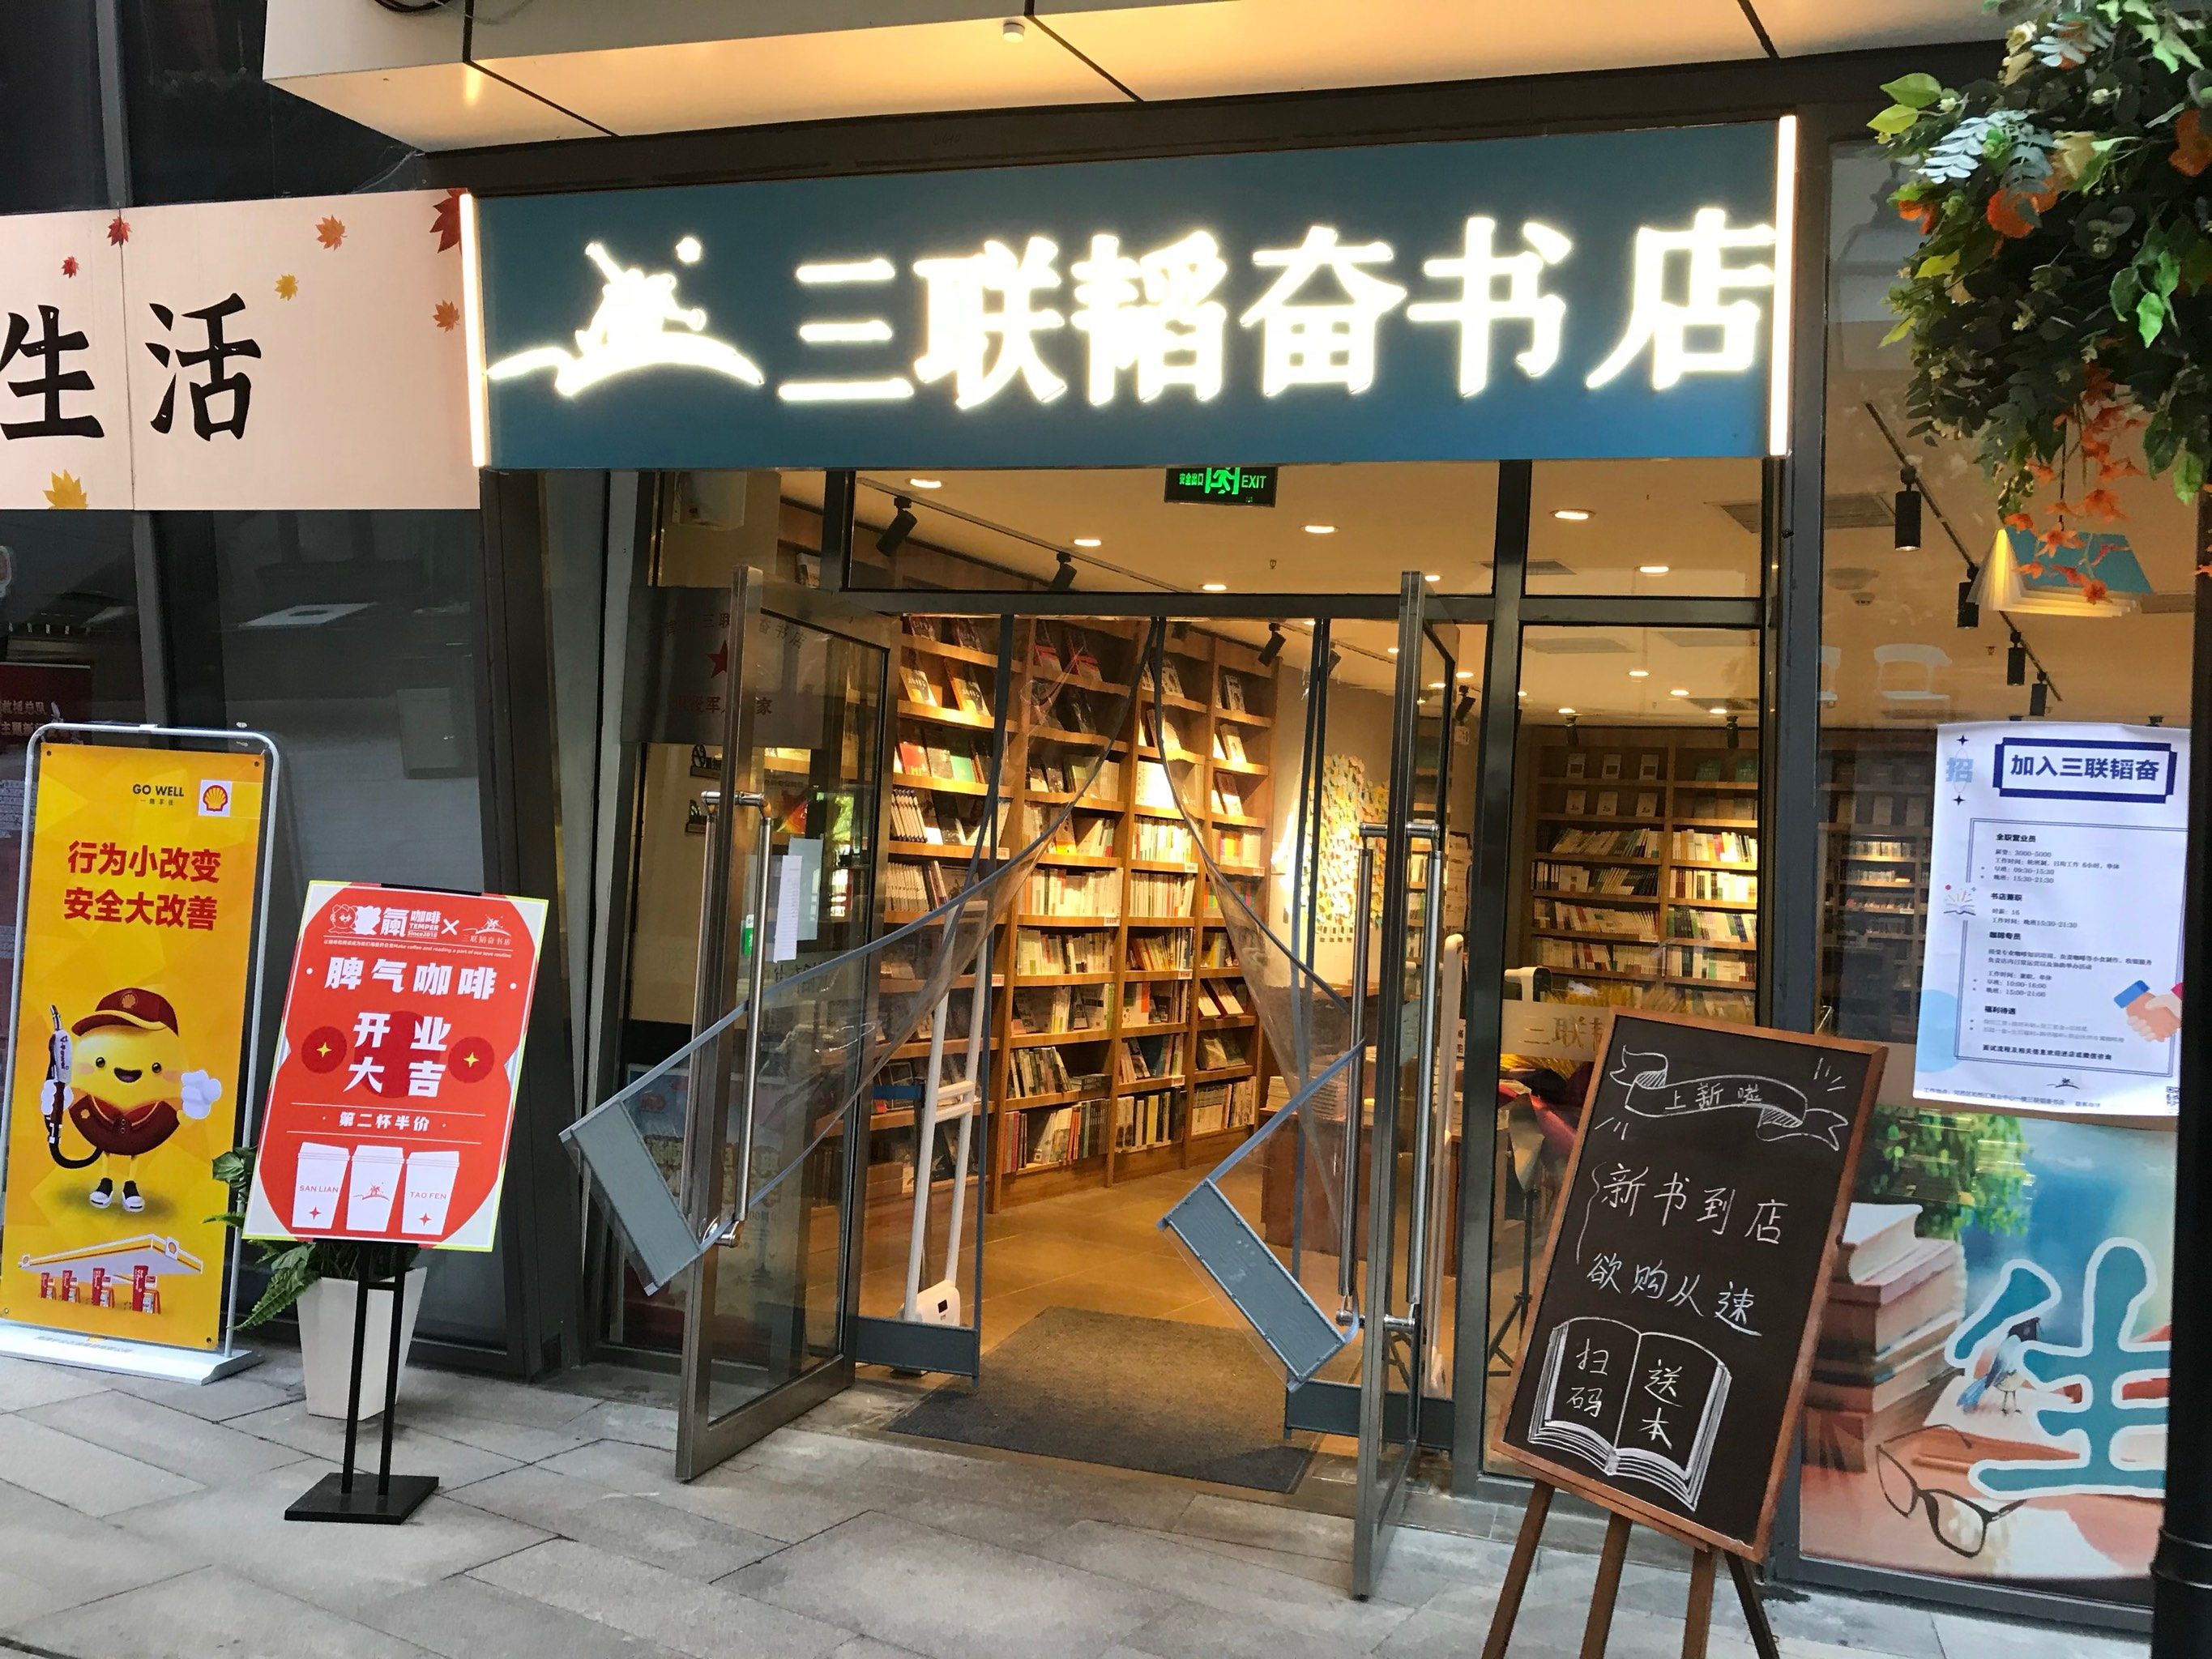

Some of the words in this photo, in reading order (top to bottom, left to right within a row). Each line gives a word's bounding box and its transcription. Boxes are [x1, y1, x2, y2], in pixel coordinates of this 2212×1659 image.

[778, 205, 1778, 410] 三联韬奋书店
[0, 292, 262, 442] 生活
[1179, 472, 1204, 486] 安全出口
[1241, 475, 1266, 488] EXIT
[2010, 754, 2160, 782] 加入三联韬奋
[133, 783, 152, 795] GO
[156, 786, 185, 797] WELL
[67, 839, 221, 883] 行为小改变
[64, 886, 218, 931] 安全大改善
[410, 910, 442, 924] 咖啡
[409, 923, 440, 932] TEMPER
[324, 956, 497, 1000] 脾气咖啡
[352, 1012, 451, 1052] 开业
[343, 1056, 449, 1098] 大吉
[338, 1111, 431, 1132] 第二杯半价
[299, 1183, 318, 1193] SAN
[318, 1184, 339, 1194] LIAN
[410, 1190, 427, 1199] TAO
[429, 1191, 446, 1201] FEN
[1600, 1162, 1789, 1246] 新书到店
[1586, 1252, 1763, 1337] 欲购从速
